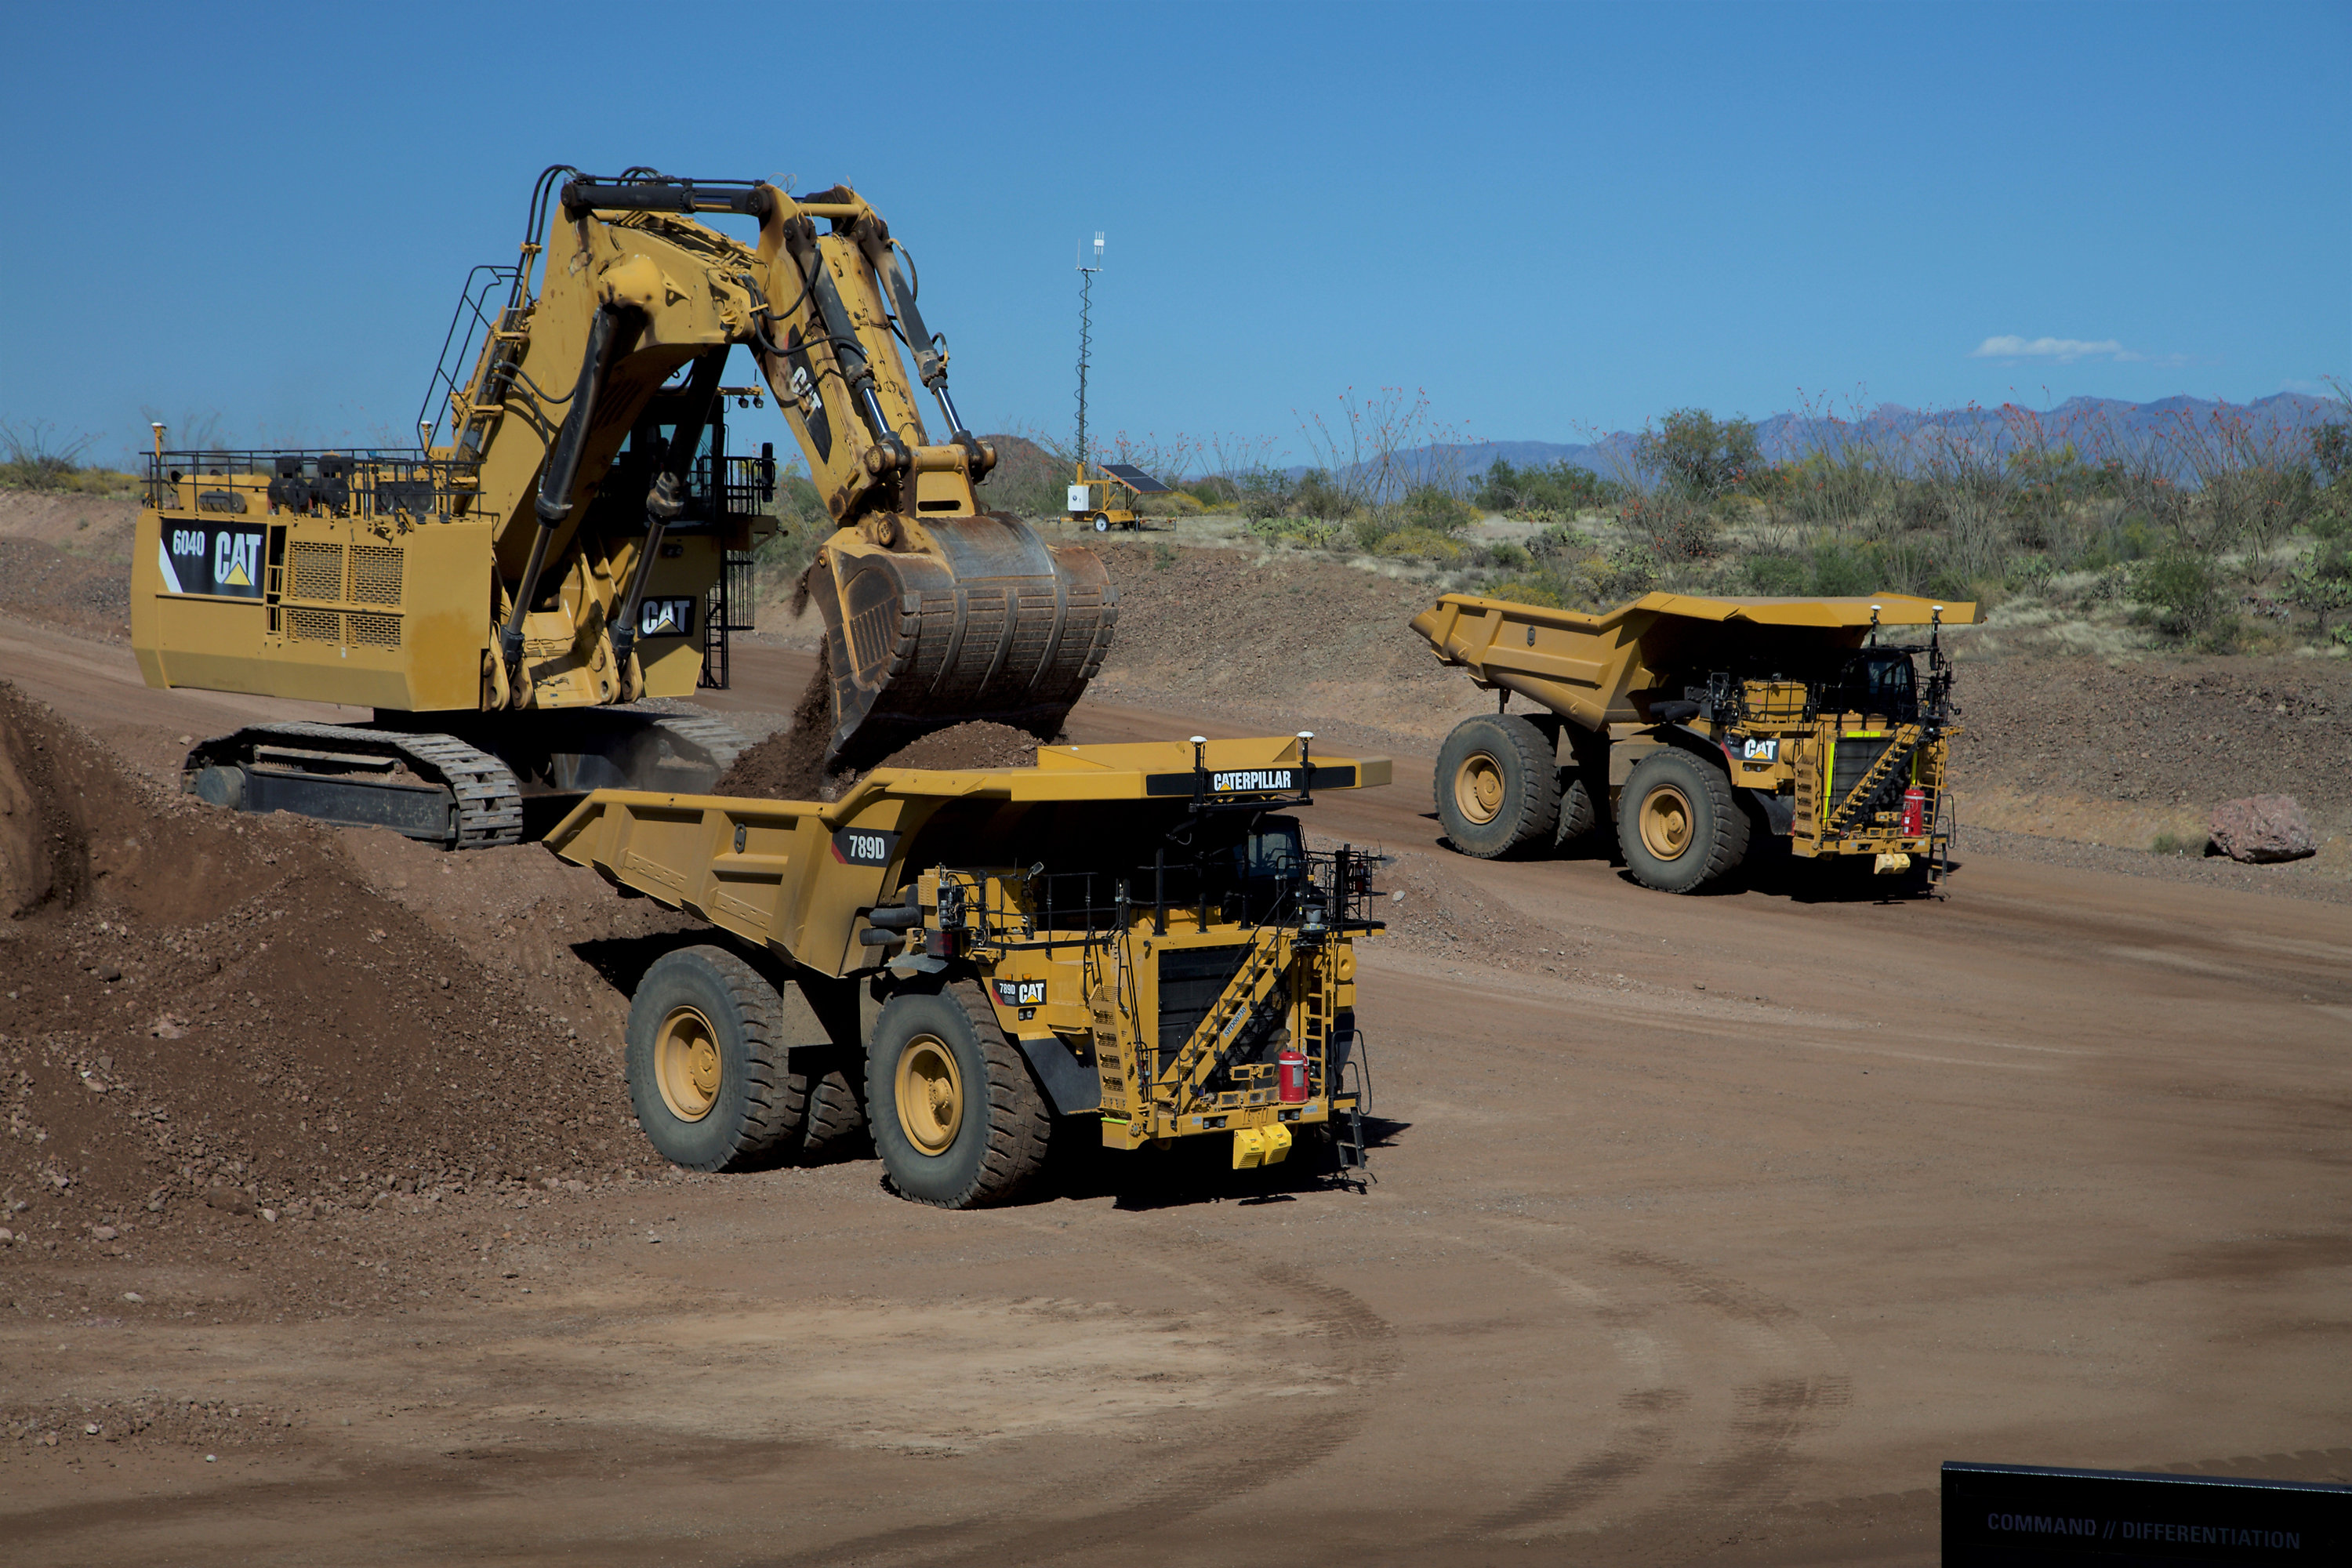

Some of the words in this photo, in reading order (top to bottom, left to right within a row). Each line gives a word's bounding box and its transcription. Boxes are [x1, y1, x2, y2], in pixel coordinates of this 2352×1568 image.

[173, 529, 205, 556] 6040
[214, 531, 261, 586] CAT
[642, 601, 690, 634] CAT
[1744, 739, 1777, 760] CAT
[1214, 771, 1291, 791] CATERPILLAR
[849, 835, 885, 859] 789D
[999, 983, 1016, 995] 789D
[1019, 983, 1044, 1004] CAT
[1987, 1512, 2096, 1536] COMMAND
[2123, 1521, 2300, 1549] DIFFERENTIATION
